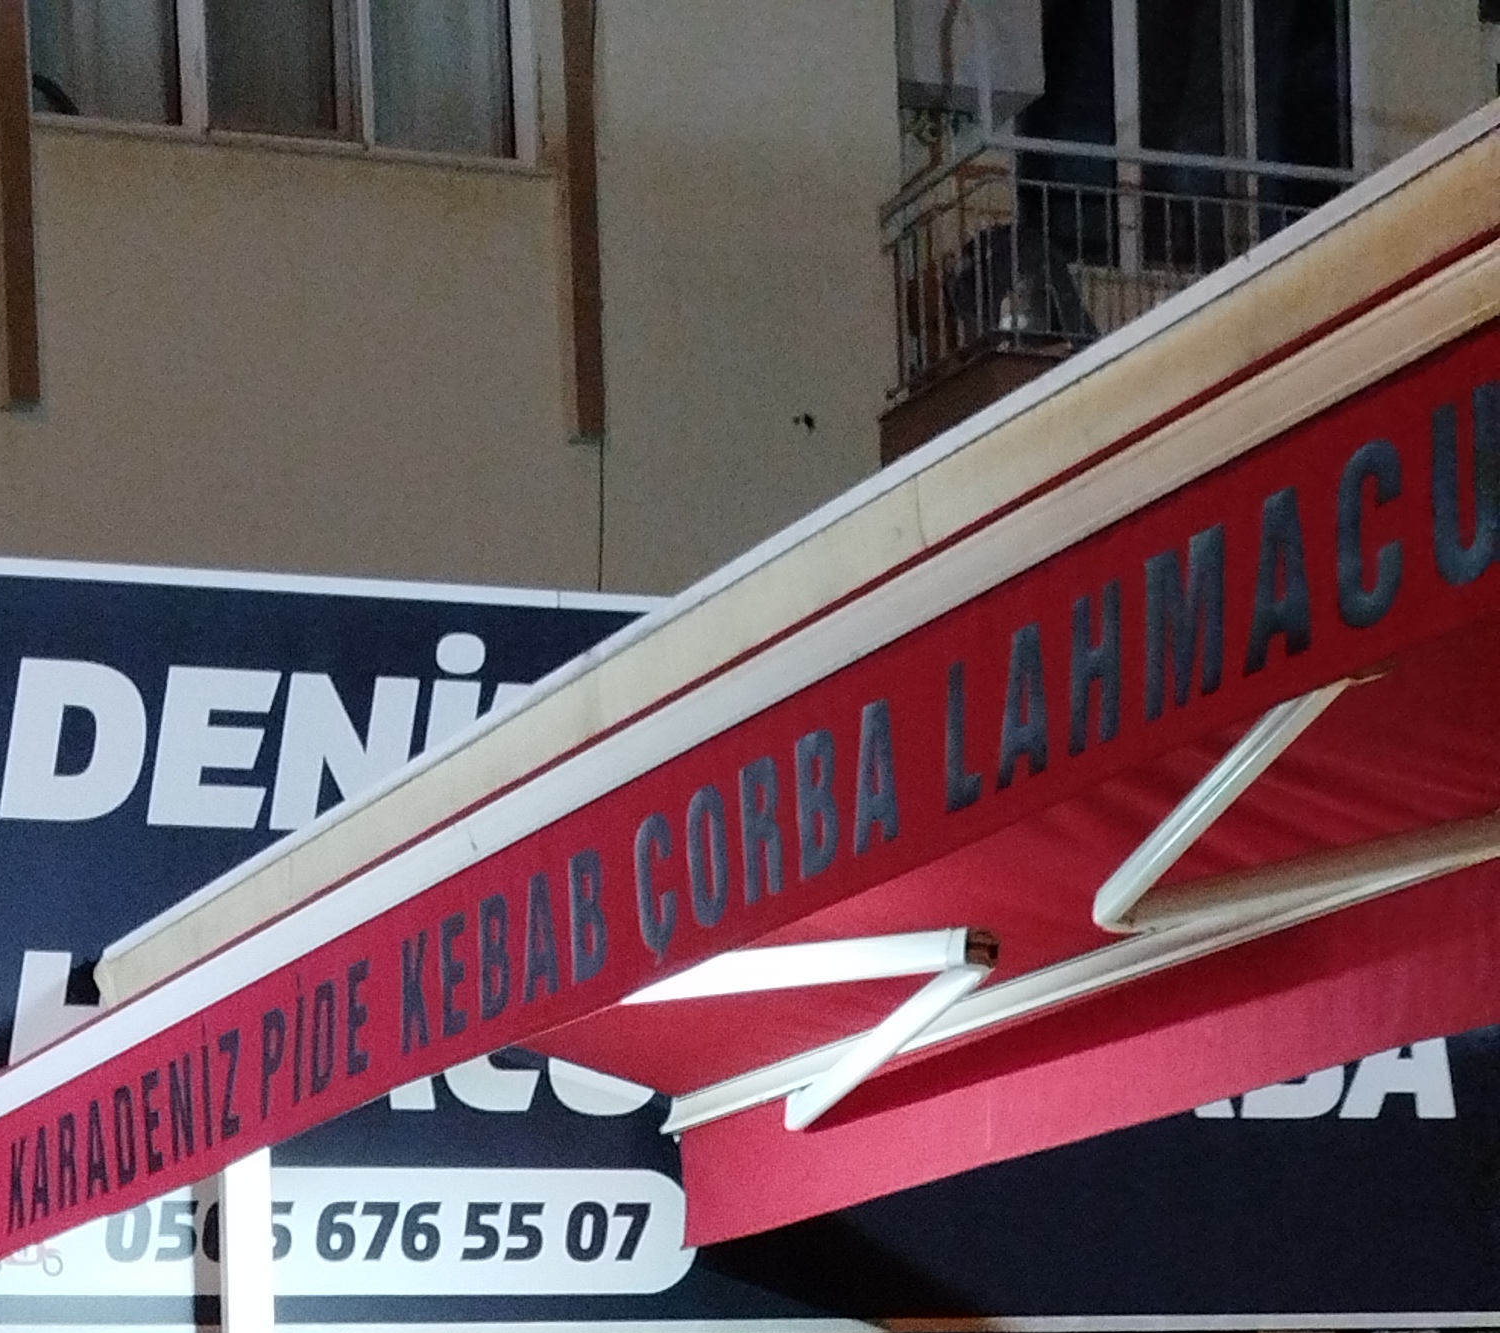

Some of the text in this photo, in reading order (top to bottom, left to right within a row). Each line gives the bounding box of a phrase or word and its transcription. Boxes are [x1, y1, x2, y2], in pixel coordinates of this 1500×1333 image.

[401, 847, 608, 1055] KEBAB
[634, 698, 900, 966] ÇORBA
[315, 1200, 441, 1262] 676
[460, 1200, 544, 1262] 55
[566, 1200, 652, 1262] 07
